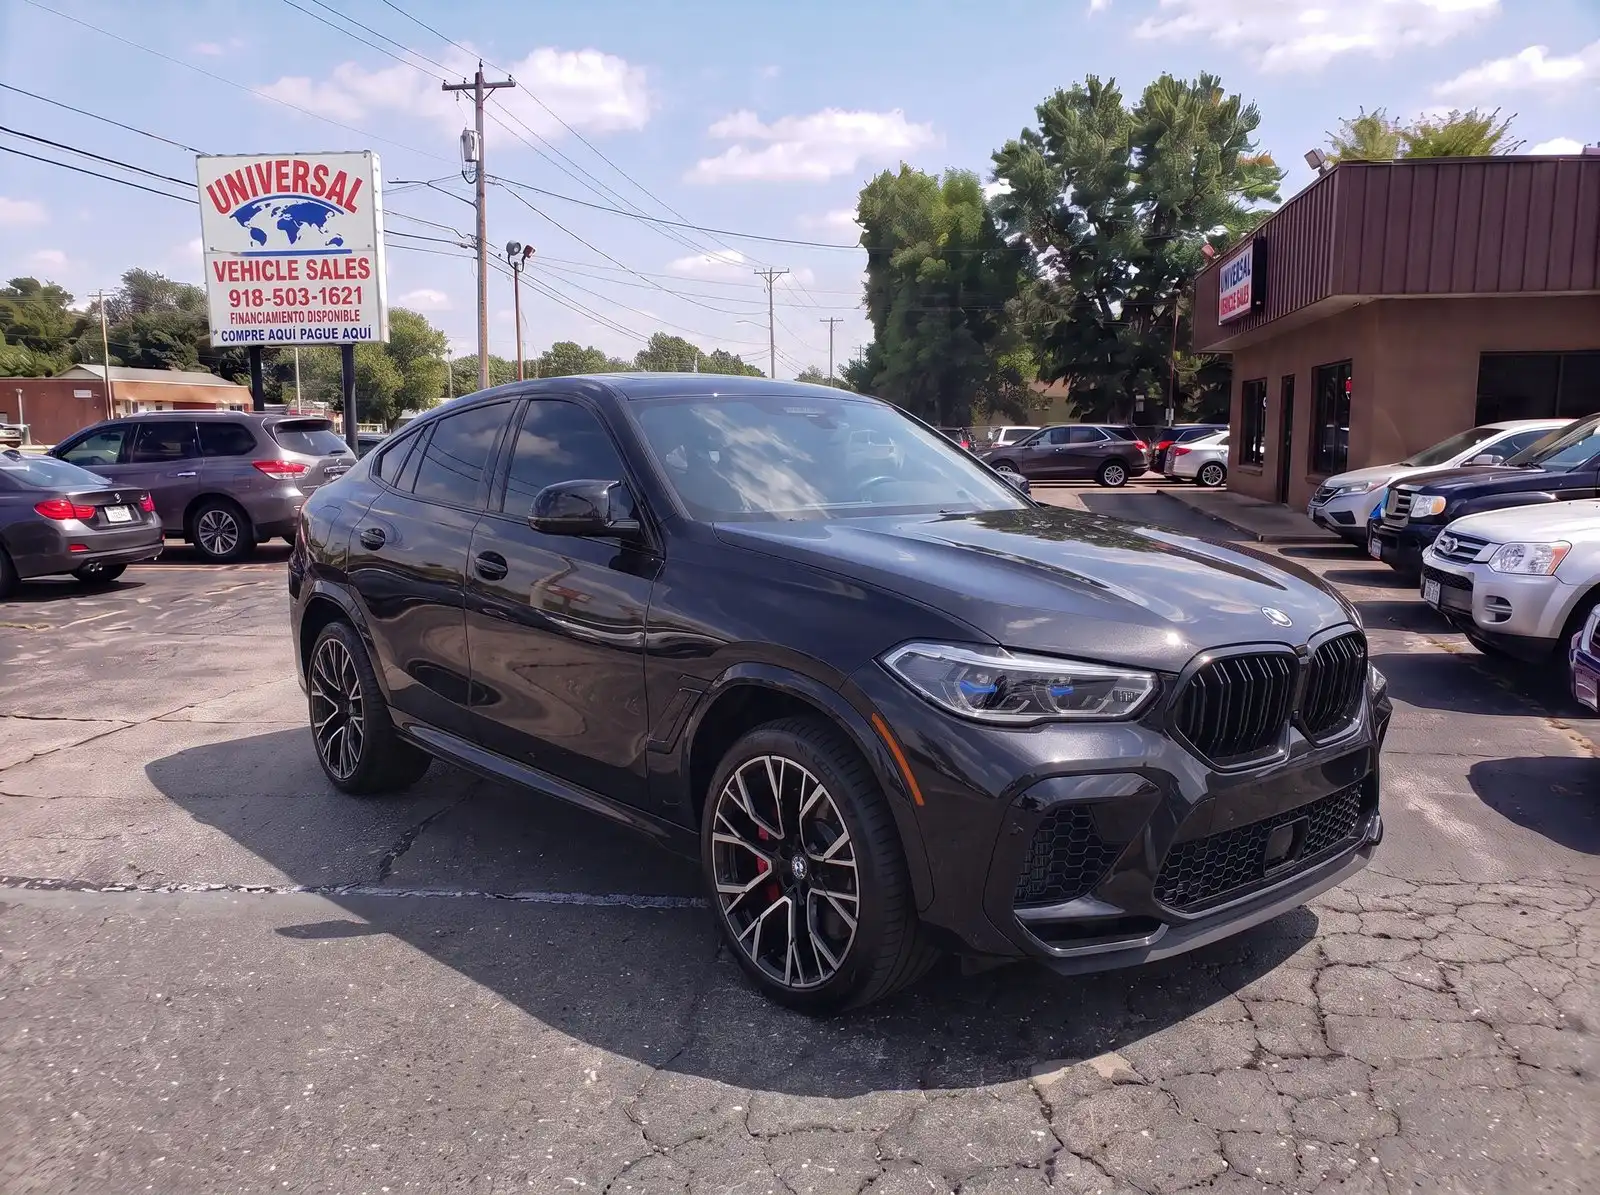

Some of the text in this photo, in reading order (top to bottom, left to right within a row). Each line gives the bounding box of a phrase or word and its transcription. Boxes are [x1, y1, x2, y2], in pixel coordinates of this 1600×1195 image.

[206, 160, 363, 214] UNIVERSAL
[213, 257, 371, 282] VEHICLE SALES
[228, 286, 362, 308] 918-503-1621
[230, 309, 360, 325] FINANCIAMIENTO DISPONIBLE
[221, 325, 372, 342] COMPRE AQUÍ PAGUE AQUÍ
